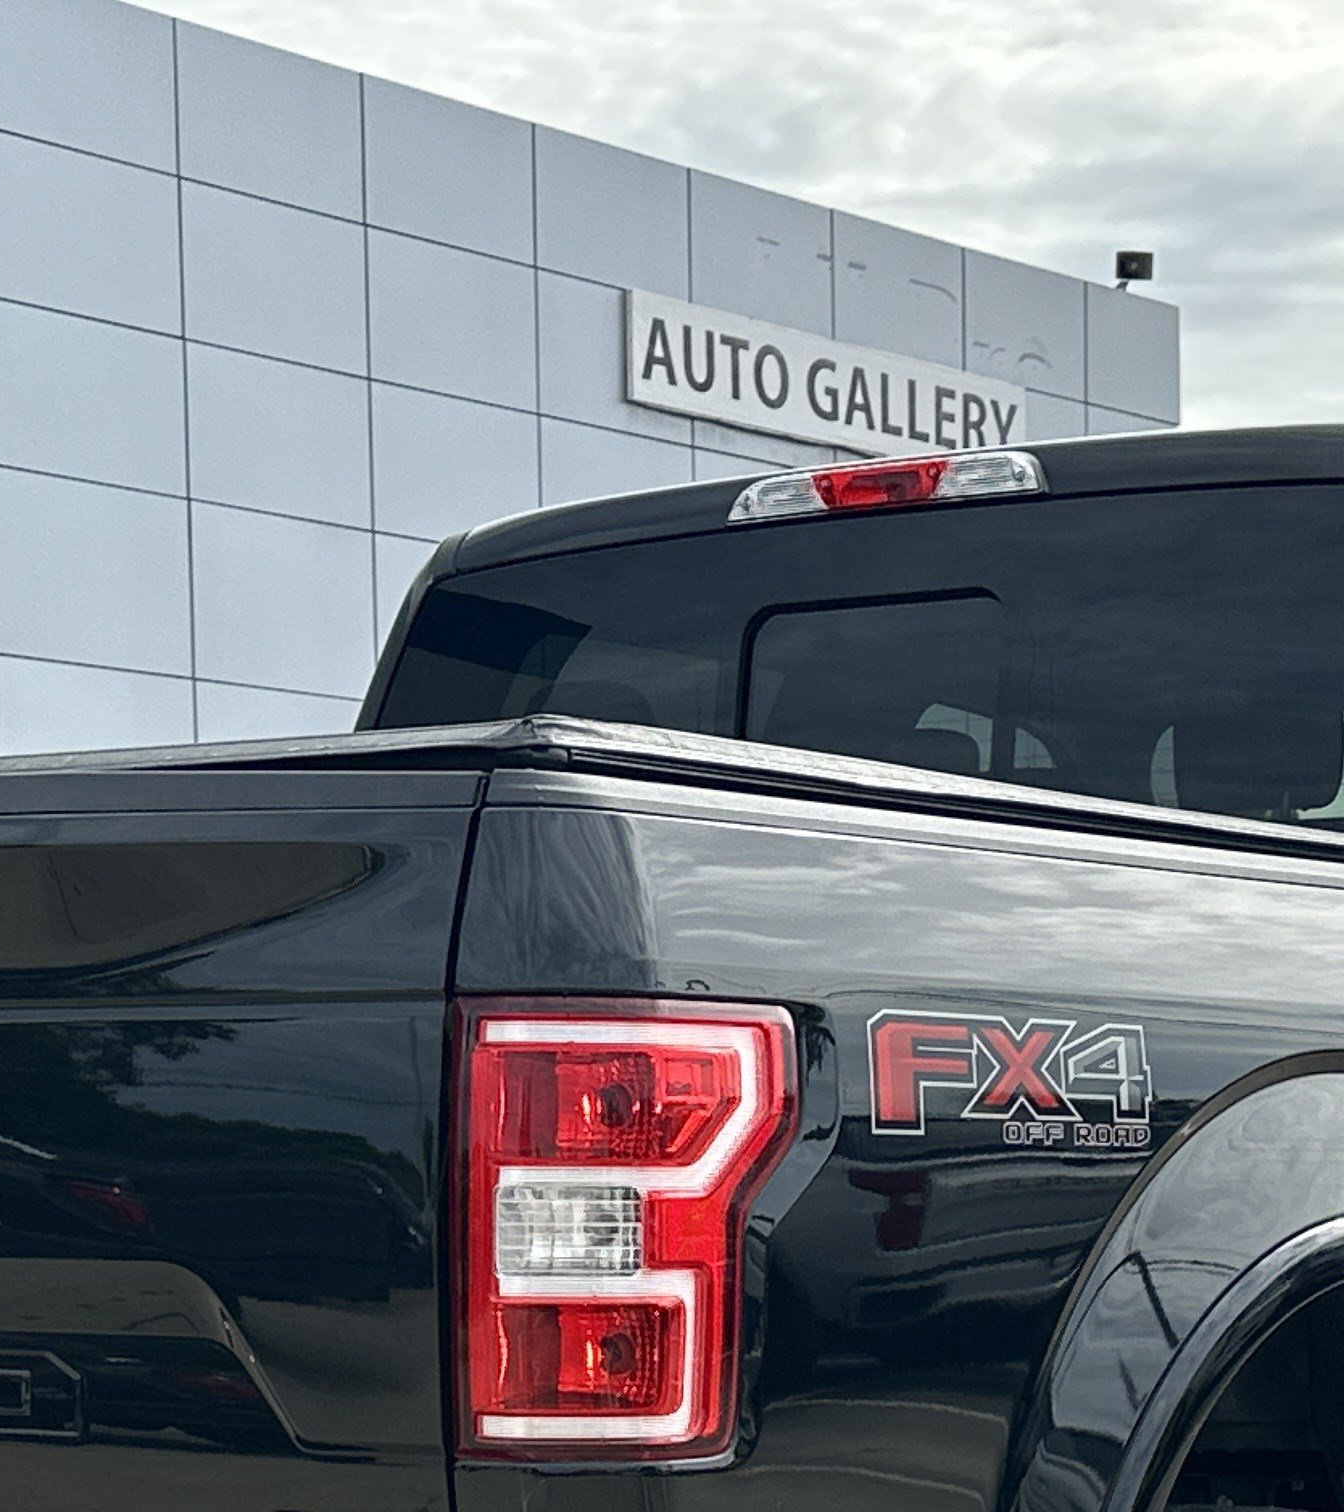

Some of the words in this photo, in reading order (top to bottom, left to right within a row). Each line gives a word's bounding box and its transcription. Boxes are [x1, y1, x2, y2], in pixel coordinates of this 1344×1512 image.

[641, 316, 789, 410] AUTO
[805, 357, 1019, 450] GALLERY
[866, 1008, 1153, 1136] FX4
[1002, 1121, 1064, 1145] OFF
[1073, 1124, 1151, 1147] ROAD
